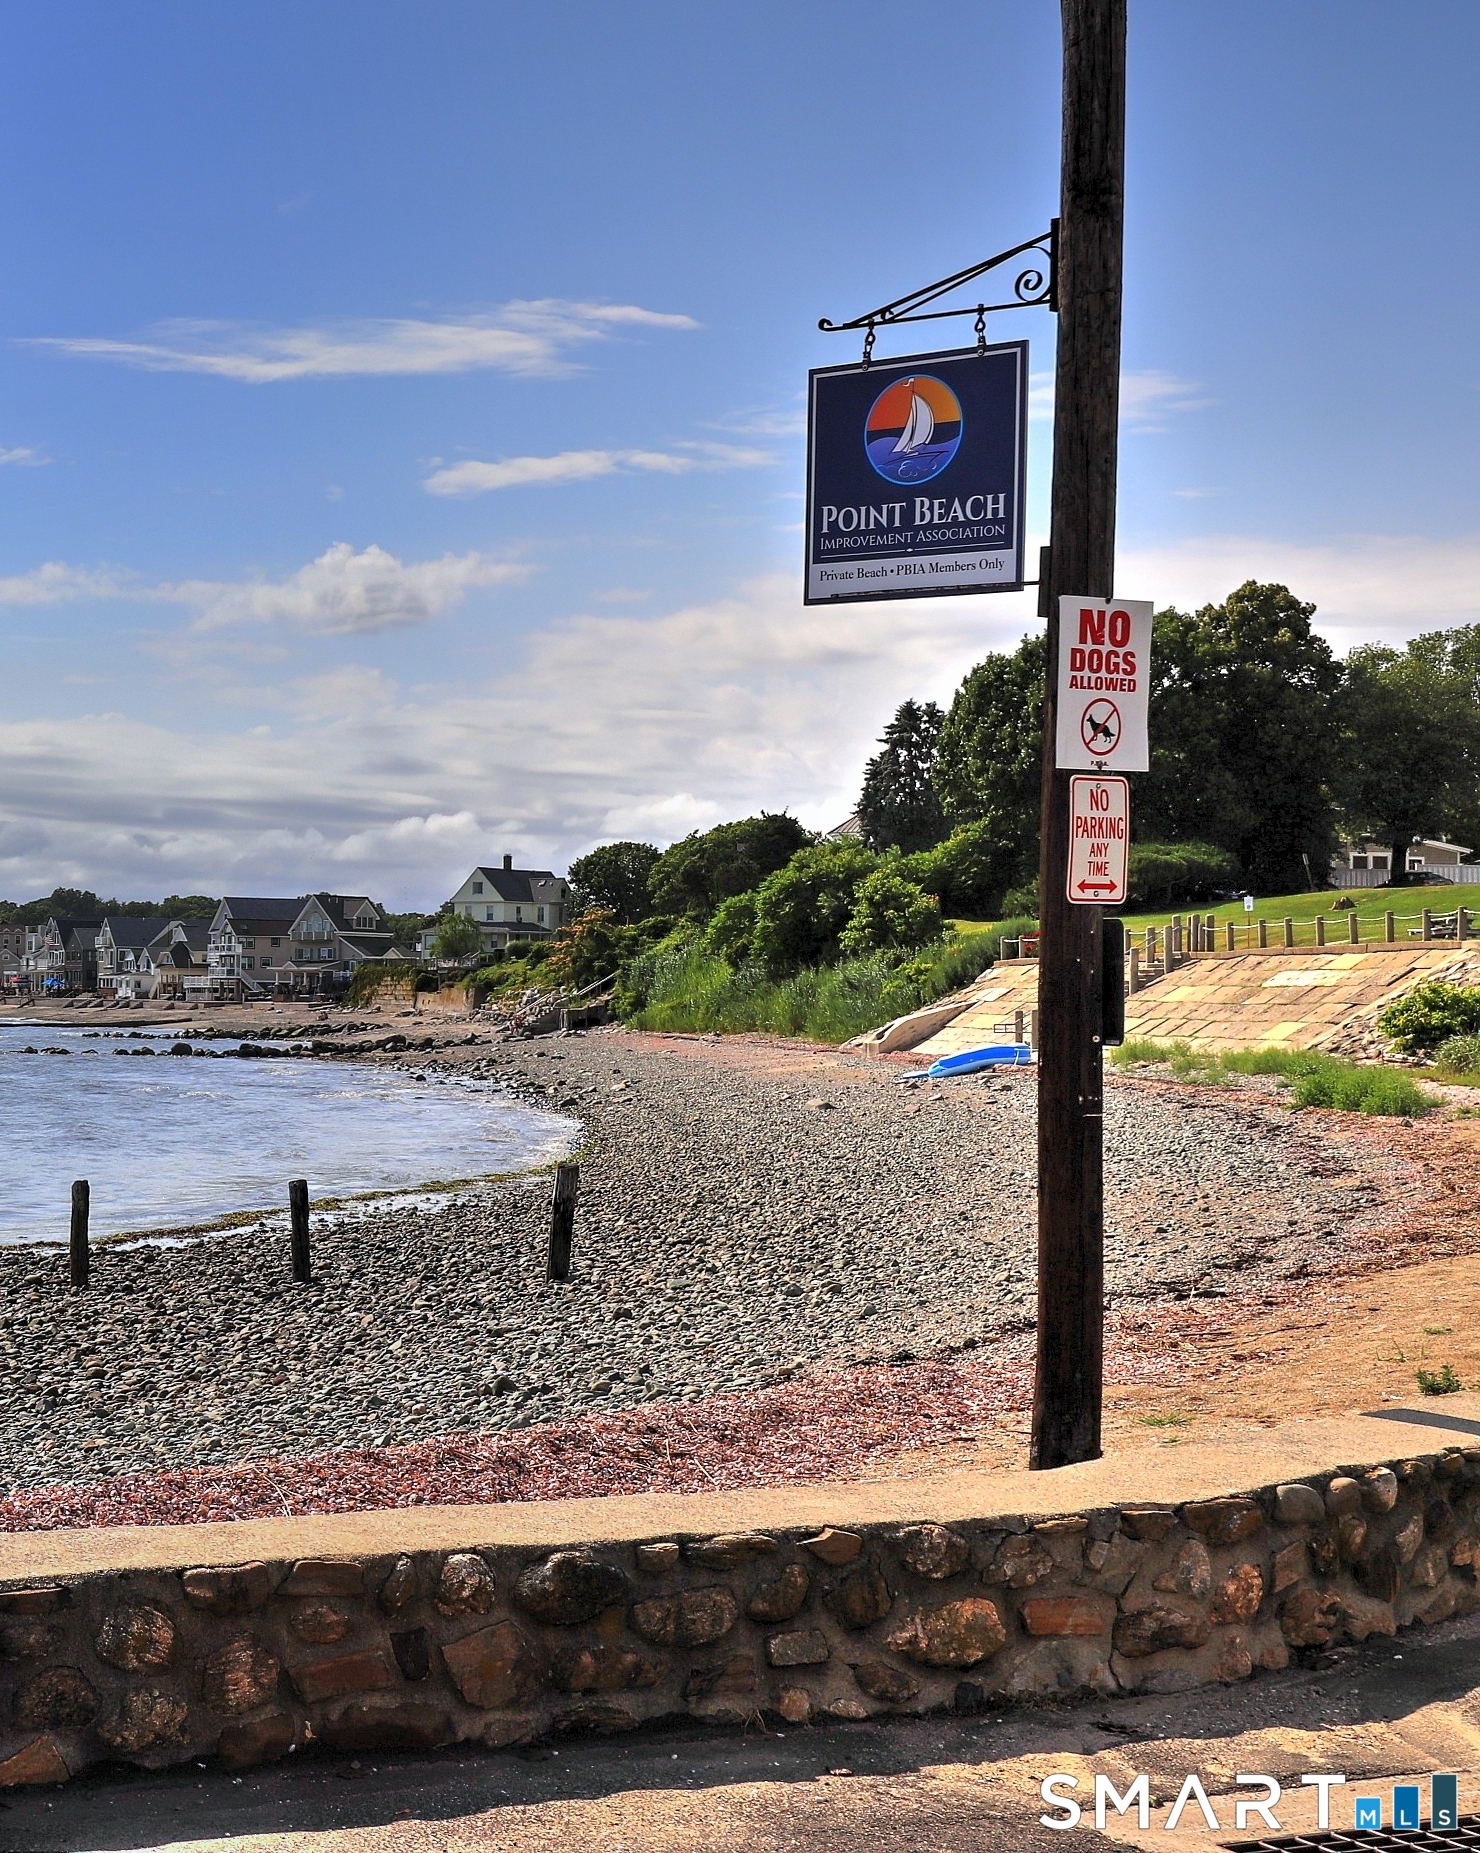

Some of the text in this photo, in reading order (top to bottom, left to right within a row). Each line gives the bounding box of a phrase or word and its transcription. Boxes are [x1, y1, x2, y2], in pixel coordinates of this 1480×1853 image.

[821, 493, 1007, 533] POINT BEACH
[820, 524, 1006, 550] IMPROVEMENT ASSOCIATION
[819, 557, 1005, 582] Private Beach PBIA Members Only
[1079, 608, 1131, 649] NO
[1070, 647, 1137, 676] DOGS
[1069, 675, 1137, 693] ALLOWED
[1090, 788, 1109, 811] NO
[1075, 816, 1124, 840] PARKING
[1089, 842, 1110, 858] ANY
[1087, 861, 1110, 877] TIME
